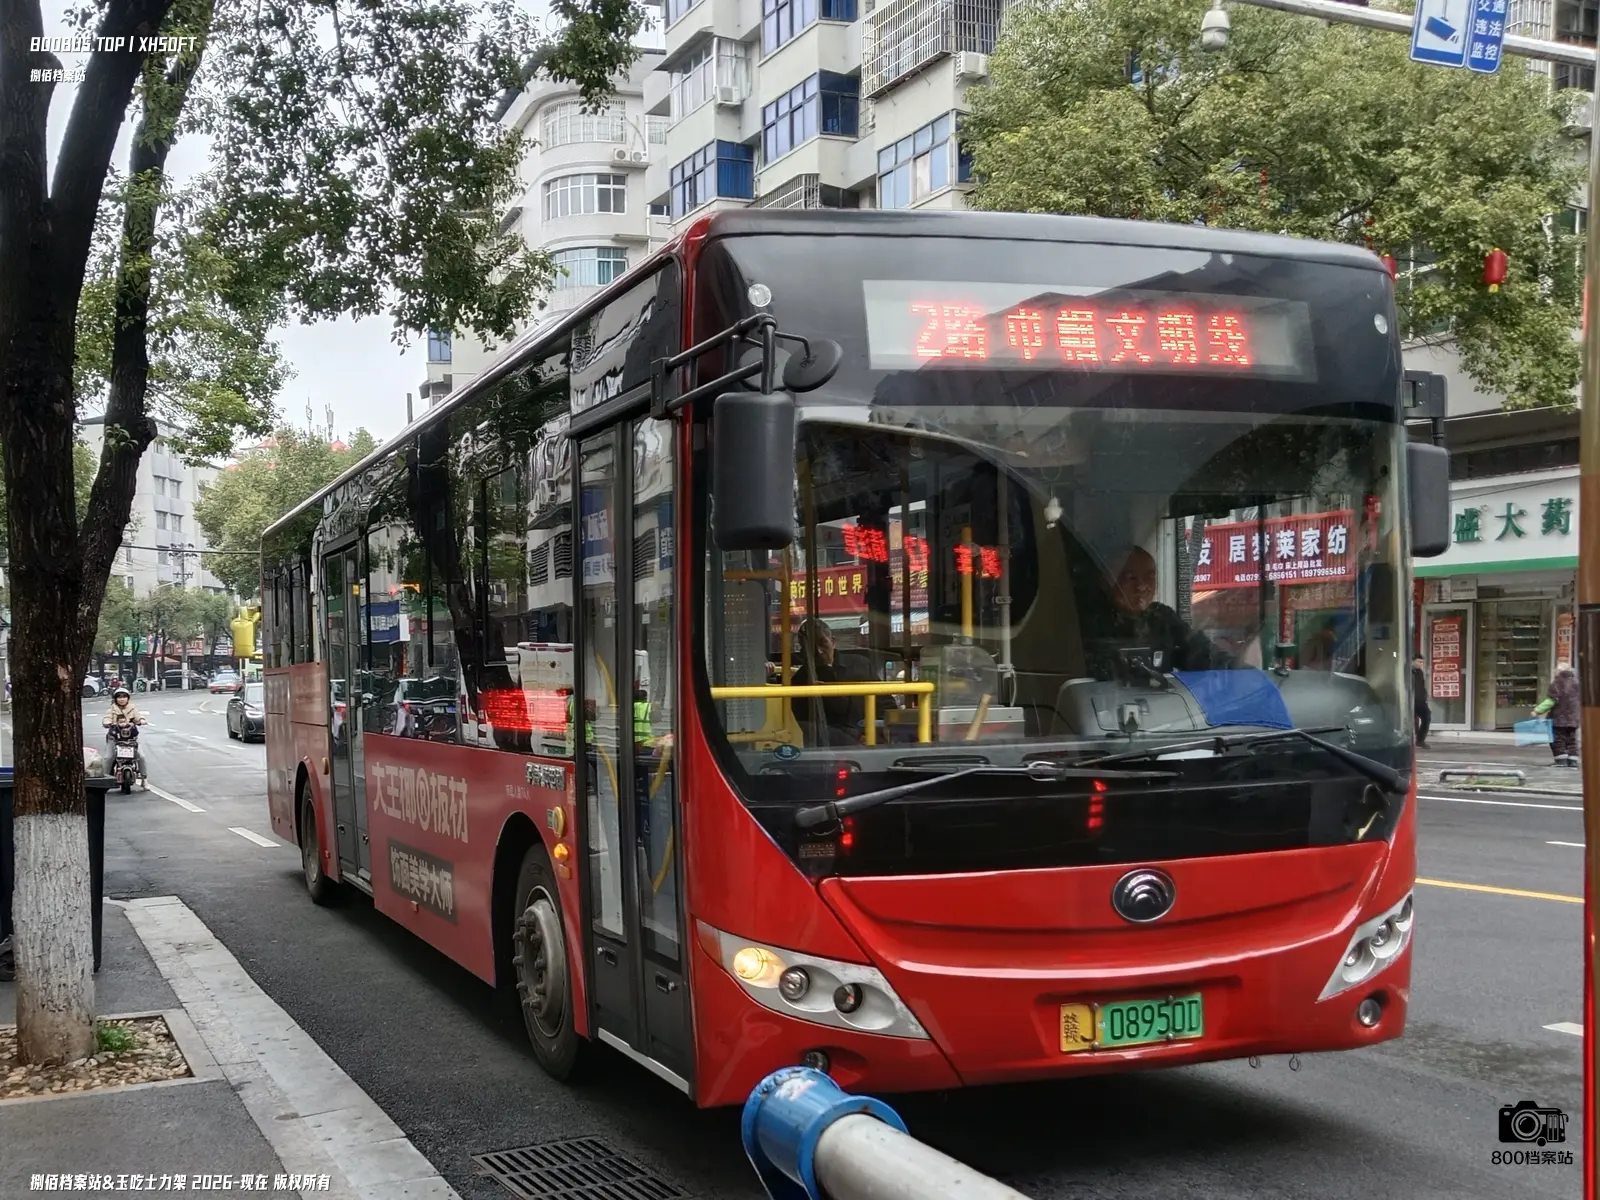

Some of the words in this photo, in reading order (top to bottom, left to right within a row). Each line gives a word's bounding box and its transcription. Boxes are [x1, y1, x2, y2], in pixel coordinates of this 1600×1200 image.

[1478, 0, 1505, 13] 交通
[1474, 18, 1502, 37] 违法
[1470, 42, 1498, 61] 监控
[911, 303, 986, 359] 2路
[1453, 497, 1573, 544] 盛大药
